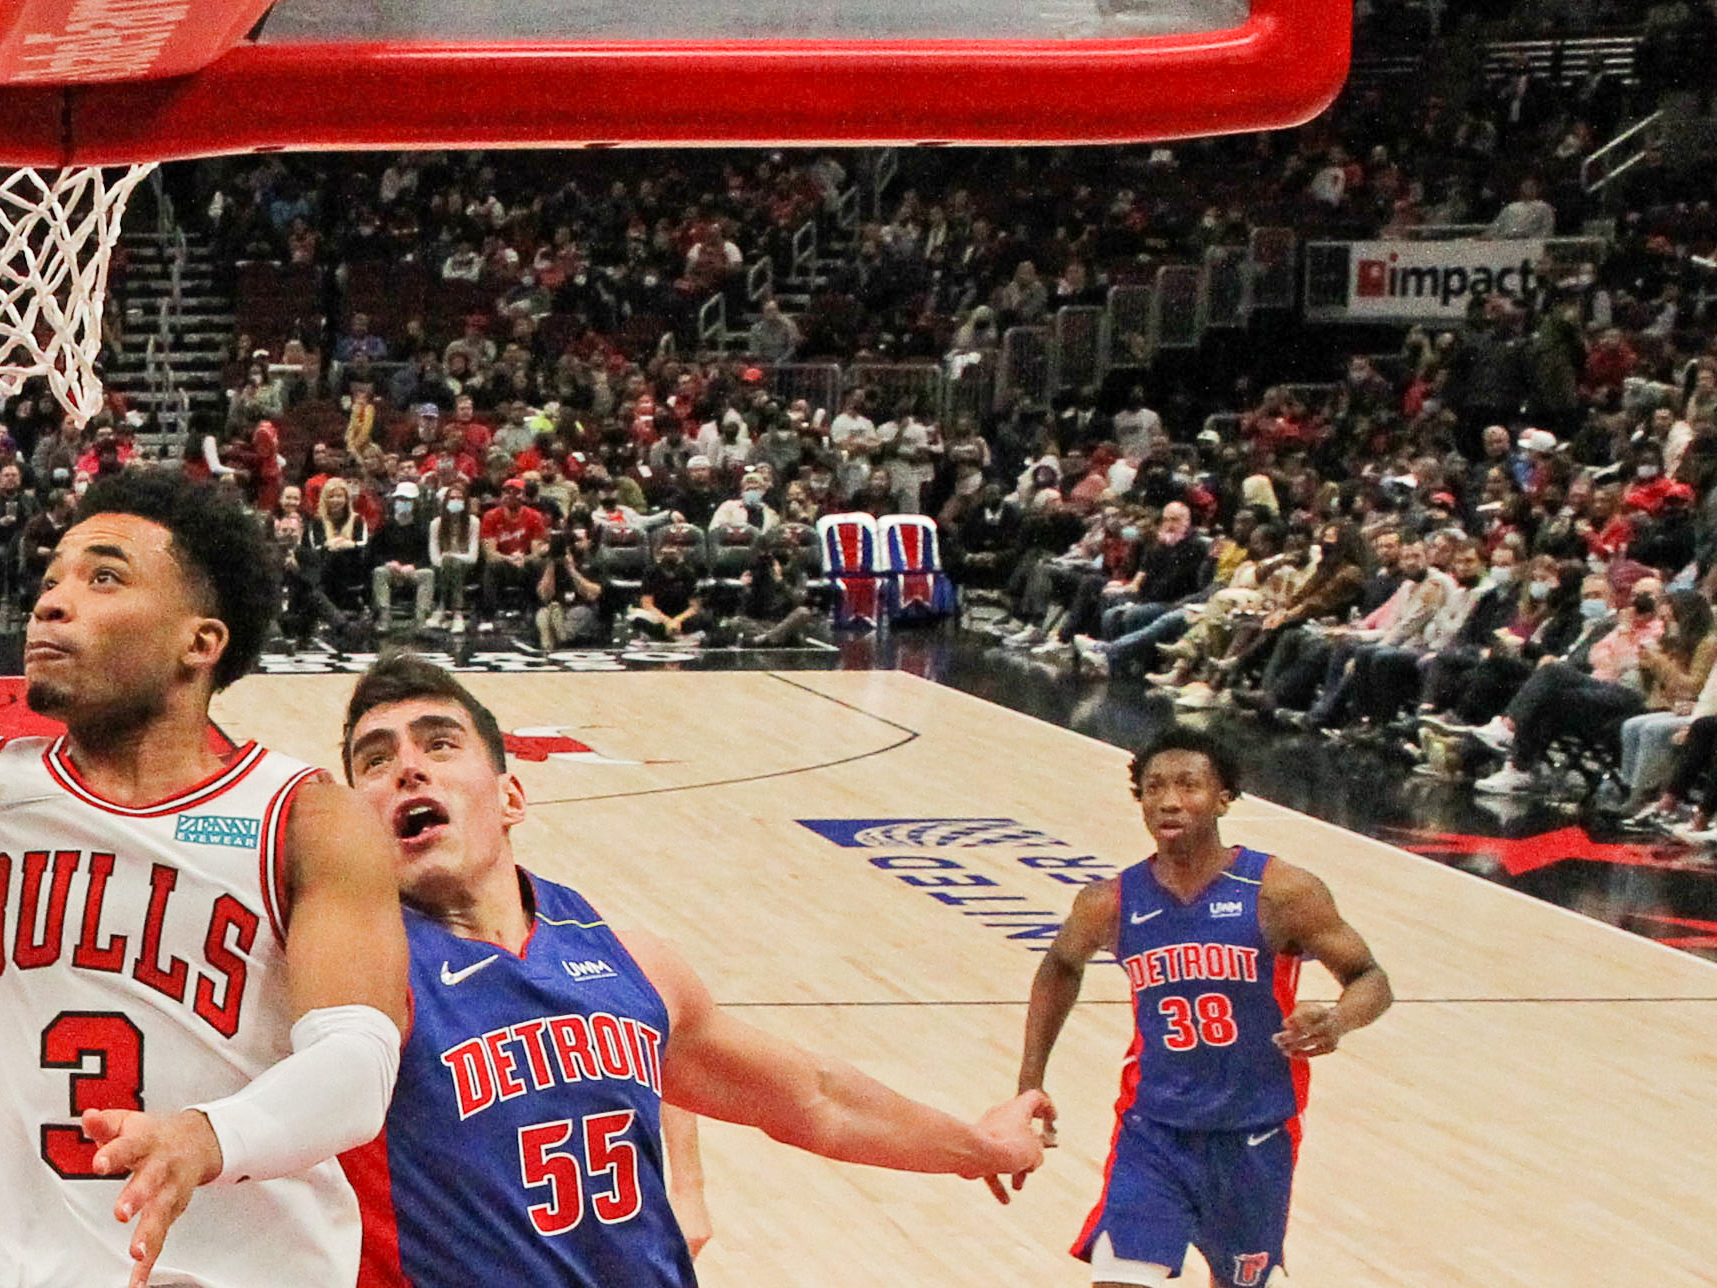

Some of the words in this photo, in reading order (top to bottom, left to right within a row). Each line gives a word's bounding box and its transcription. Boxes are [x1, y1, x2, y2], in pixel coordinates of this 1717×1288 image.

[1389, 252, 1536, 306] impact
[177, 832, 255, 847] EYEWEAR
[562, 959, 612, 978] UWM
[1123, 943, 1259, 992] DETROIT
[1158, 993, 1238, 1051] 38
[440, 1012, 662, 1121] DETROIT
[41, 1011, 145, 1180] 3
[518, 1109, 642, 1236] 55
